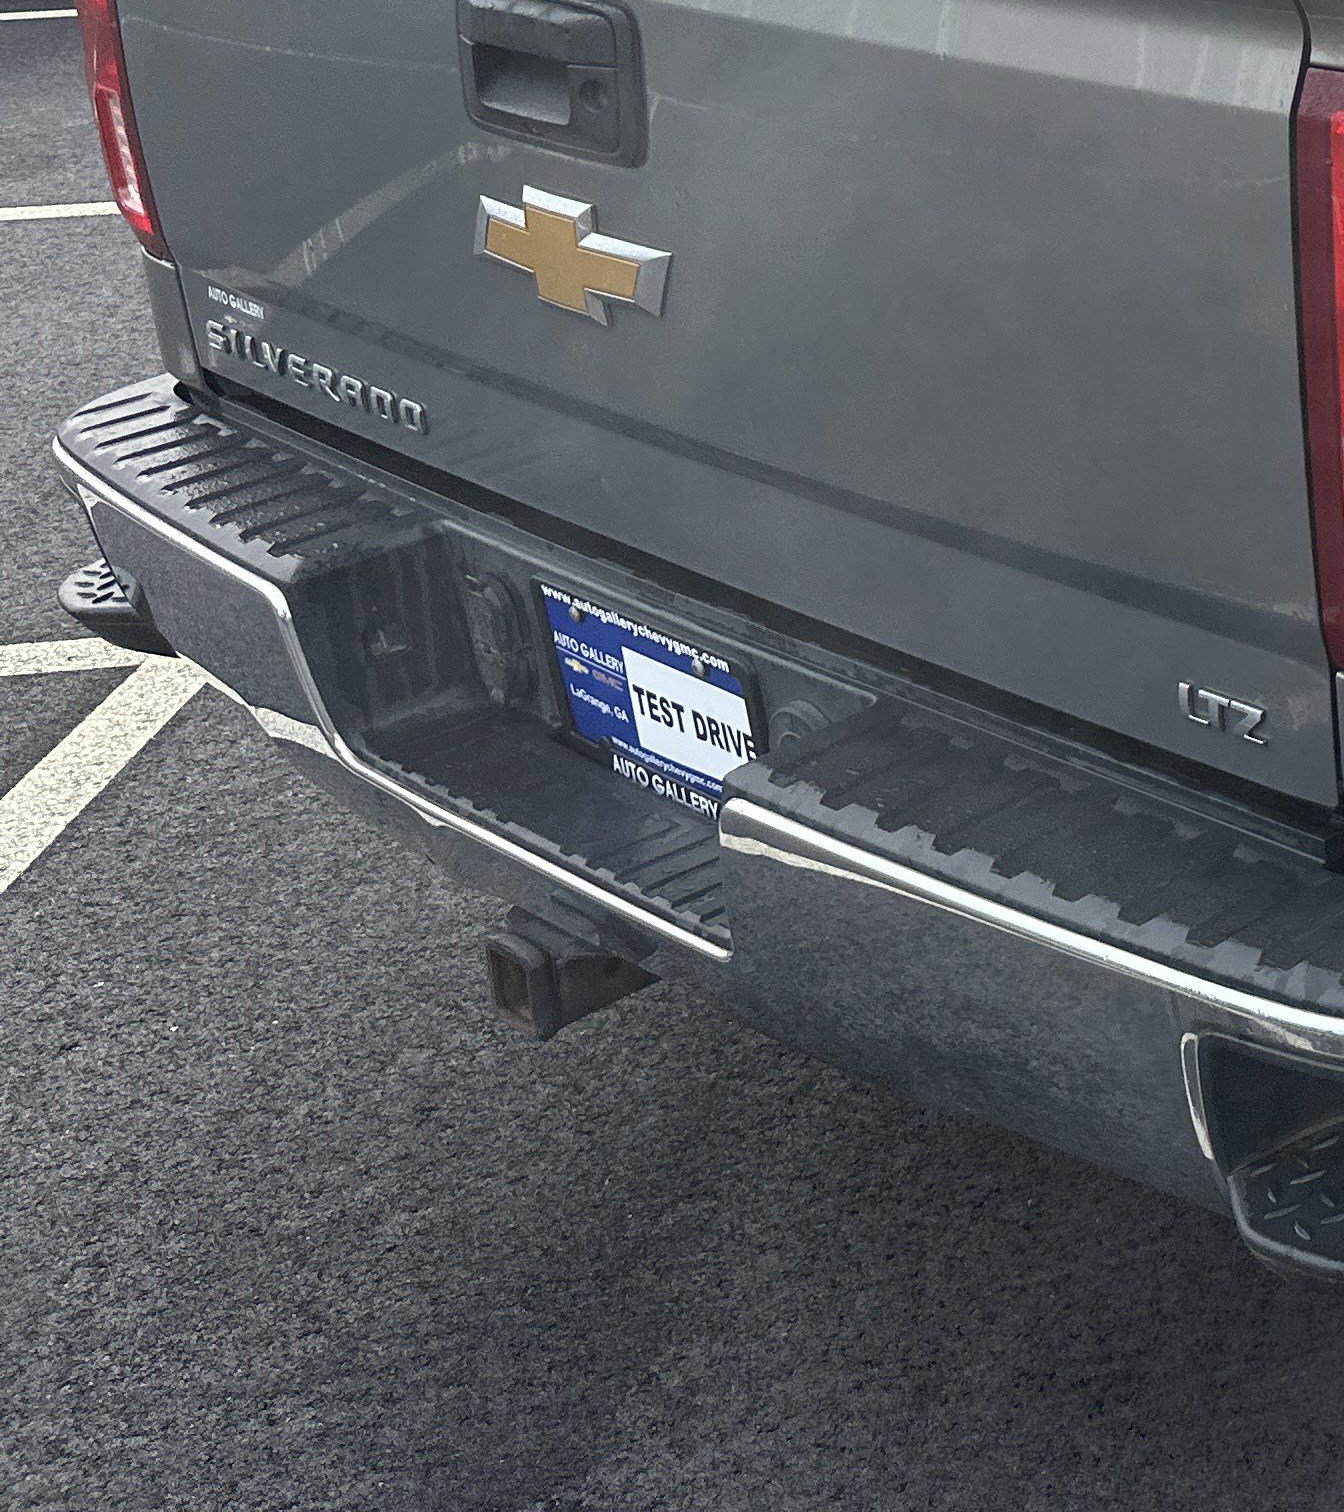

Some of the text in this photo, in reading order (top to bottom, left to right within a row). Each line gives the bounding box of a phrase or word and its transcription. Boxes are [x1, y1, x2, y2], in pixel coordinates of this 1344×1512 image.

[208, 285, 264, 320] AUTO GALLERY
[205, 319, 430, 436] SILVERADO
[541, 584, 730, 674] www.autogallerychevygmc.com
[553, 630, 625, 674] AUTO GALLERY
[613, 705, 630, 723] GA
[632, 683, 757, 760] TEST DRIVE
[1178, 680, 1268, 746] LTZ
[613, 753, 719, 821] AUTO GALLERY
